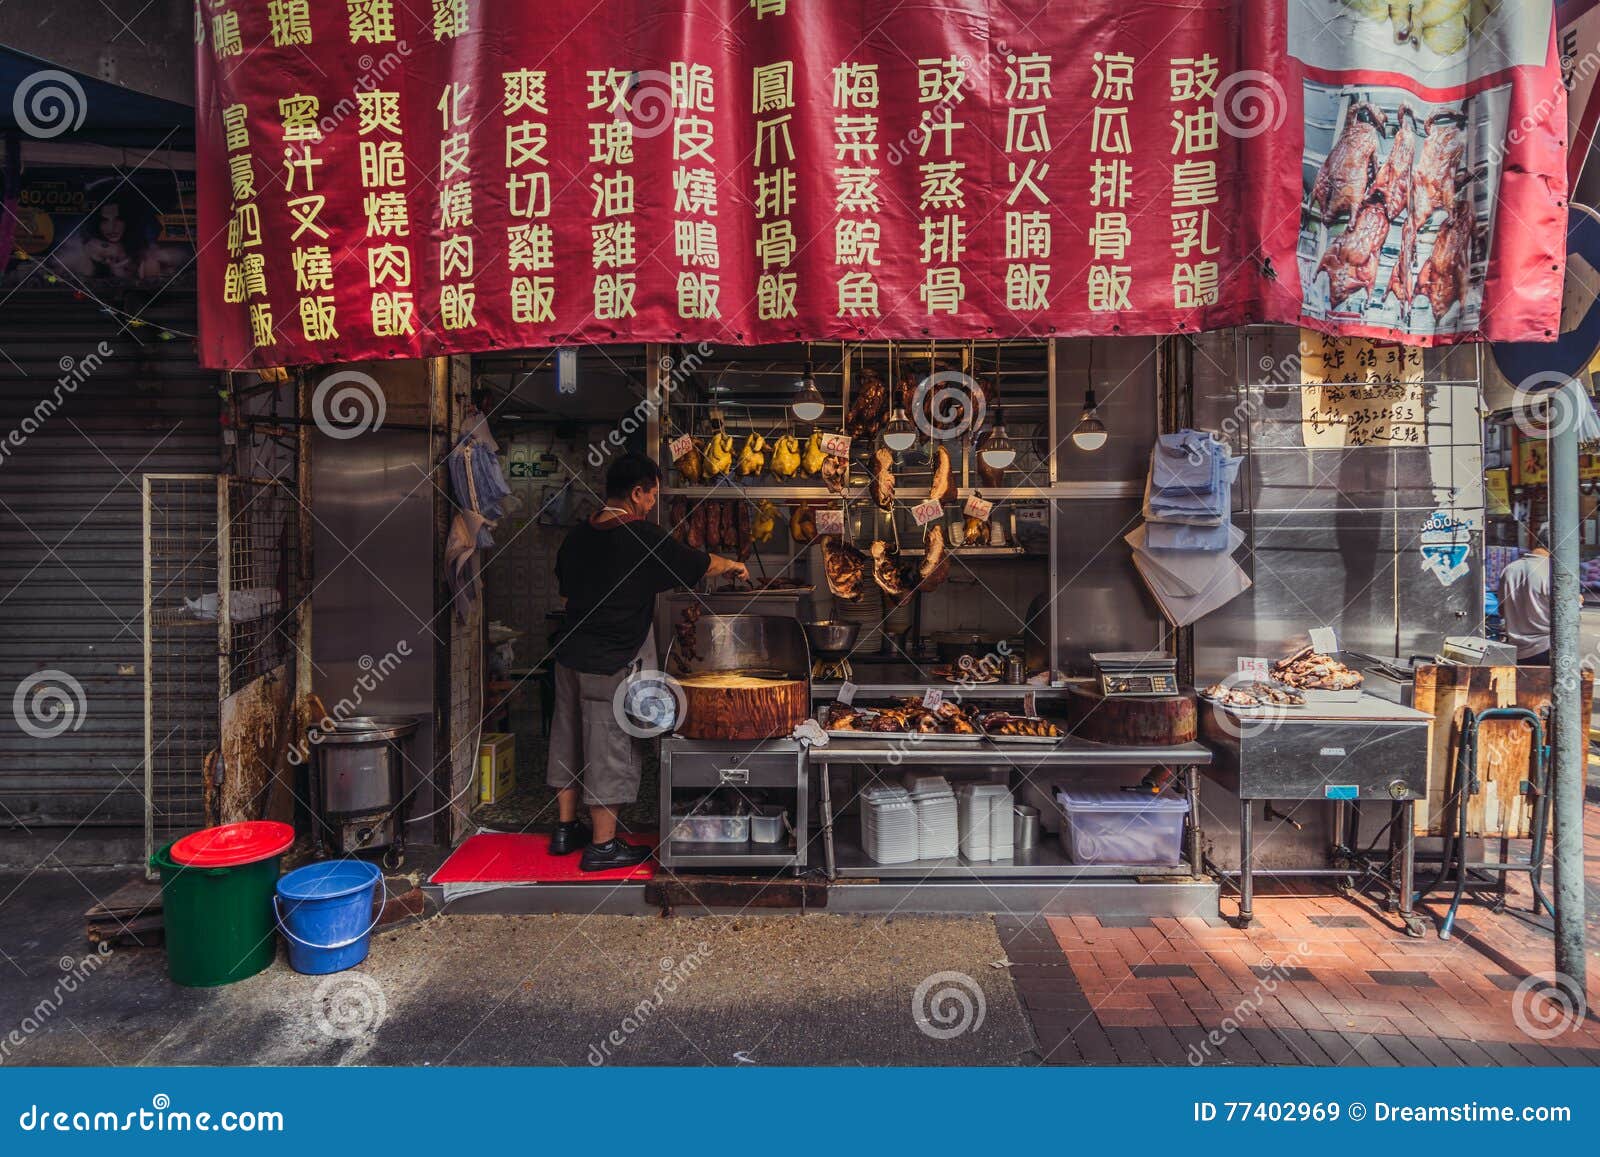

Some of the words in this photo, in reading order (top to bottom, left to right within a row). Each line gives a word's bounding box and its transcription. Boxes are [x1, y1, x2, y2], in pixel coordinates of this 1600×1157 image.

[347, 0, 397, 44] 雞
[432, 0, 469, 42] 雞
[278, 93, 340, 342] 蜜汁叉燒飯
[356, 89, 415, 337] 爽脆燒肉飯
[437, 82, 477, 330] 化皮燒肉飯
[502, 67, 556, 324] 爽皮切雞飯
[586, 67, 637, 320] 玫瑰油雞飯
[670, 61, 722, 320] 脆皮燒鴨飯
[752, 60, 799, 321] 鳳爪排骨飯
[832, 61, 882, 318] 梅菜蒸鯇魚
[918, 54, 967, 315] 豉汁蒸排骨
[1004, 52, 1052, 311] 涼瓜火腩飯
[1087, 51, 1135, 311] 涼瓜排骨飯
[1169, 53, 1220, 309] 豉油皇乳鴿
